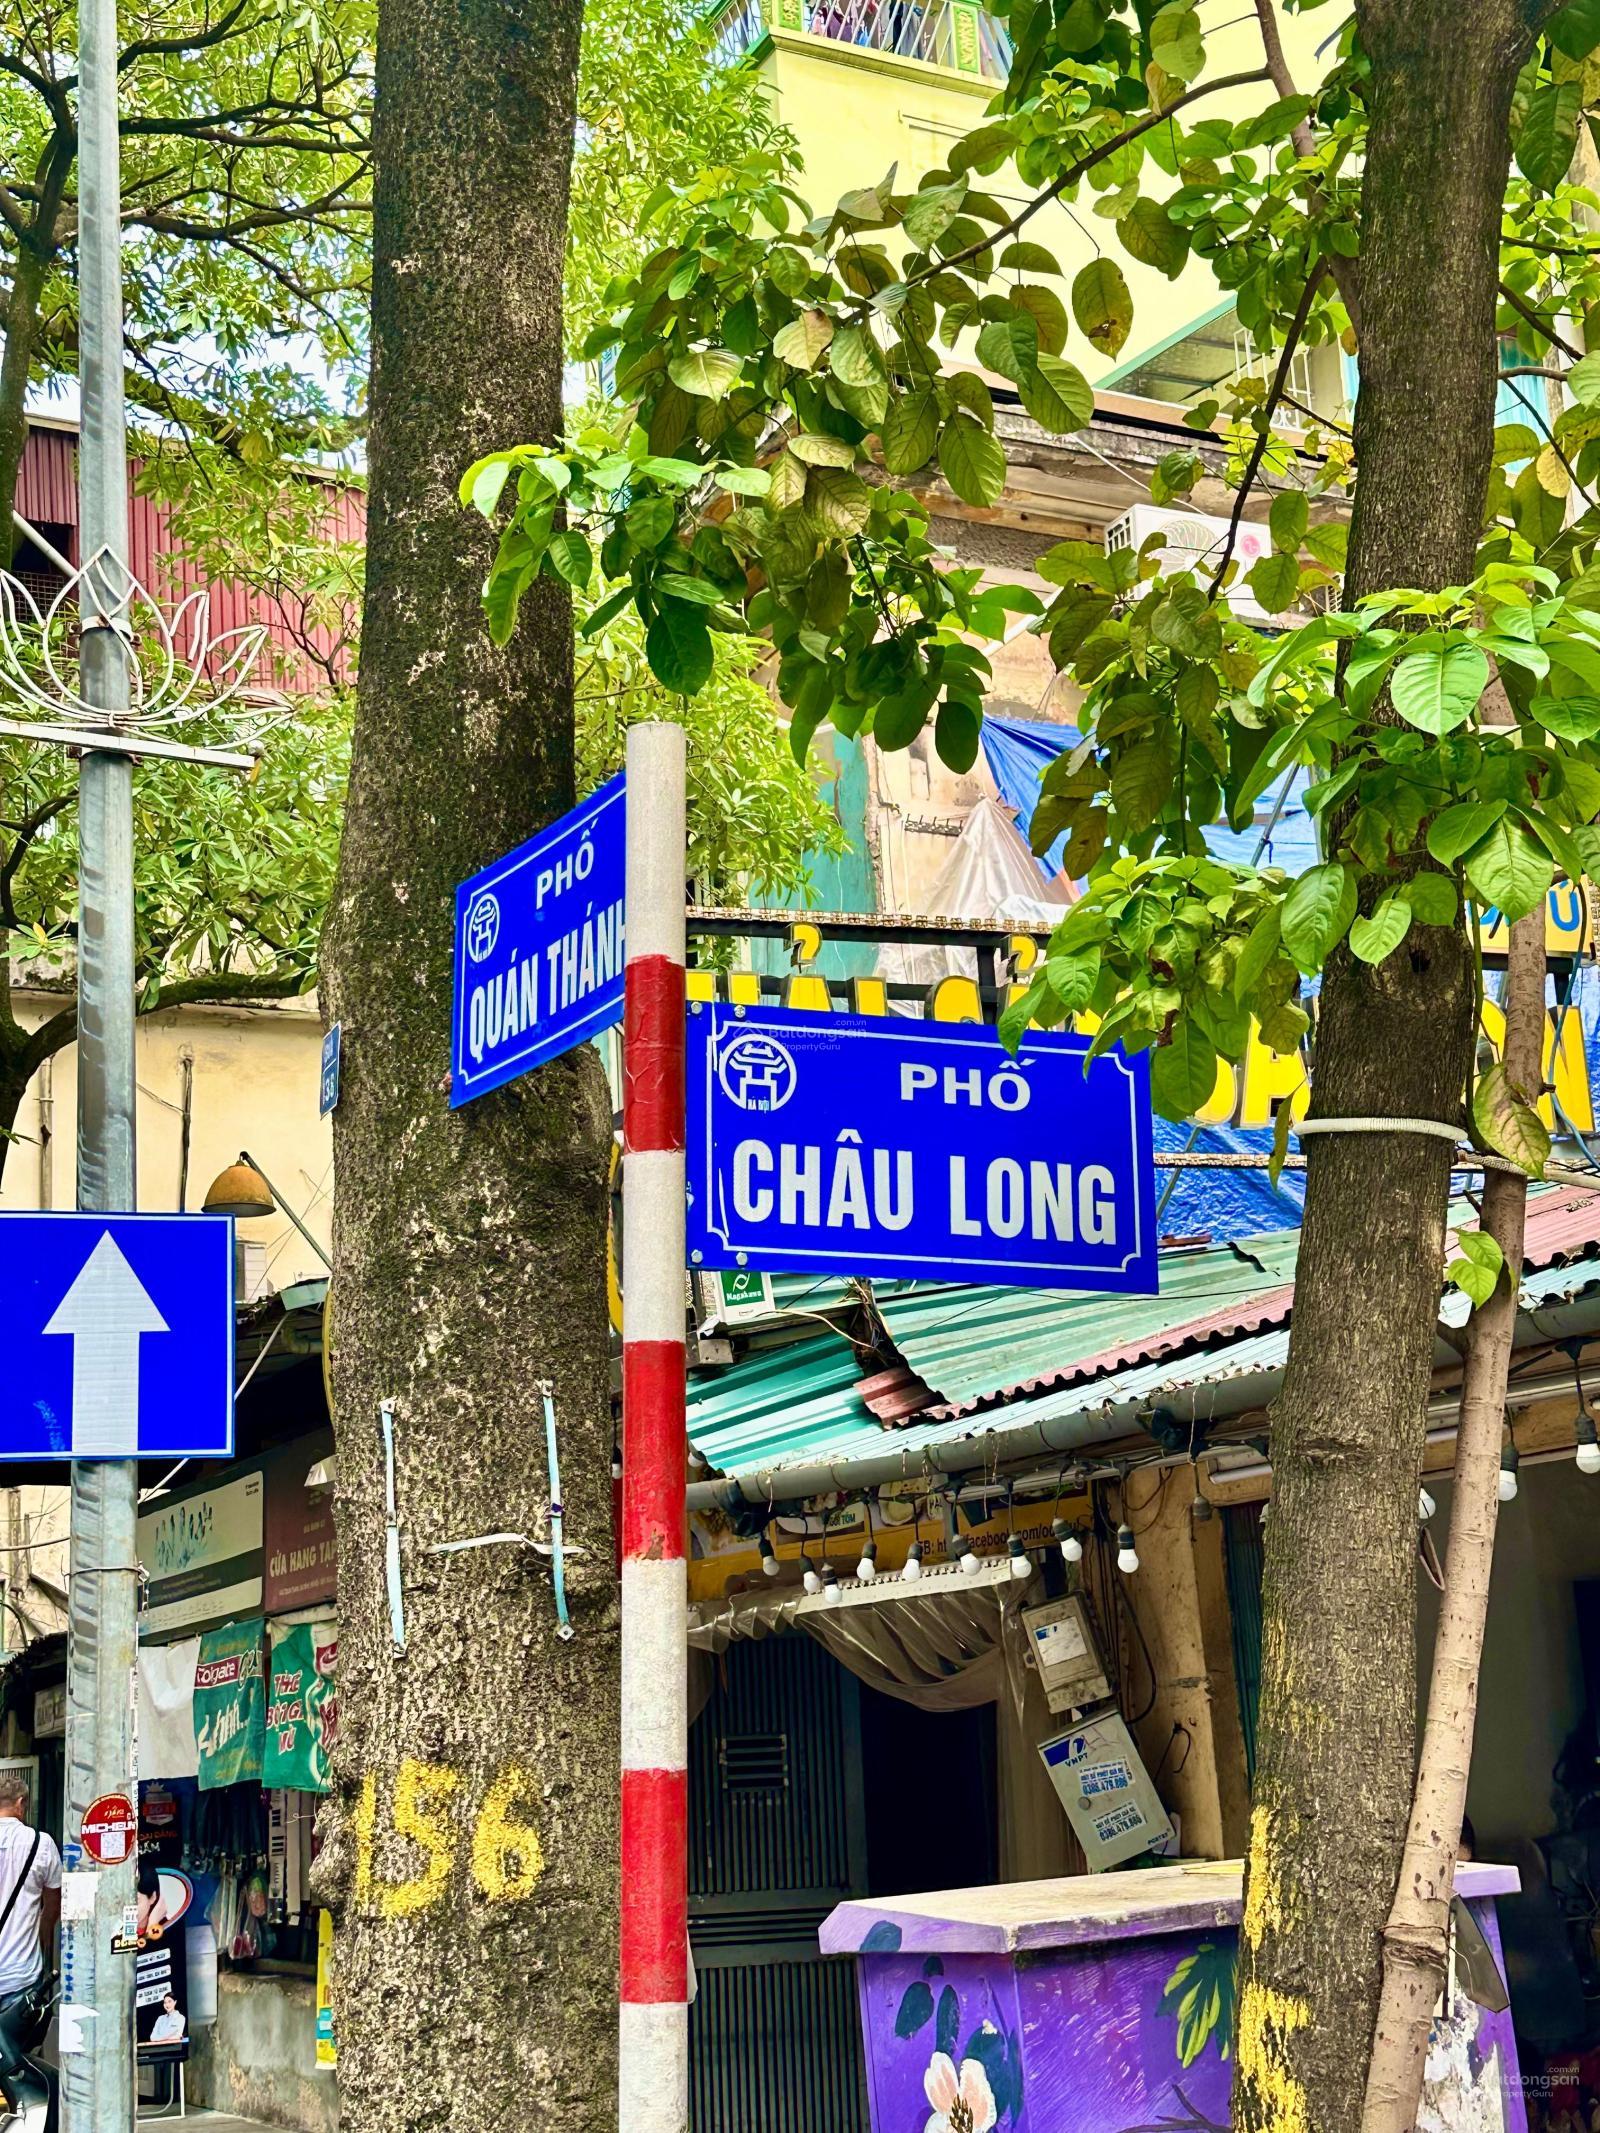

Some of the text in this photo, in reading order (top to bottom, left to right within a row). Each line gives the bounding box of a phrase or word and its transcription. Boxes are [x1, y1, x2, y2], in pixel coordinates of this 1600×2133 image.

[536, 817, 599, 910] PHỐ
[469, 948, 539, 1064] QUÁN
[900, 1058, 1037, 1112] PHỐ
[733, 1128, 1117, 1246] CHÂU LONG
[1064, 1752, 1088, 1768] VNPT
